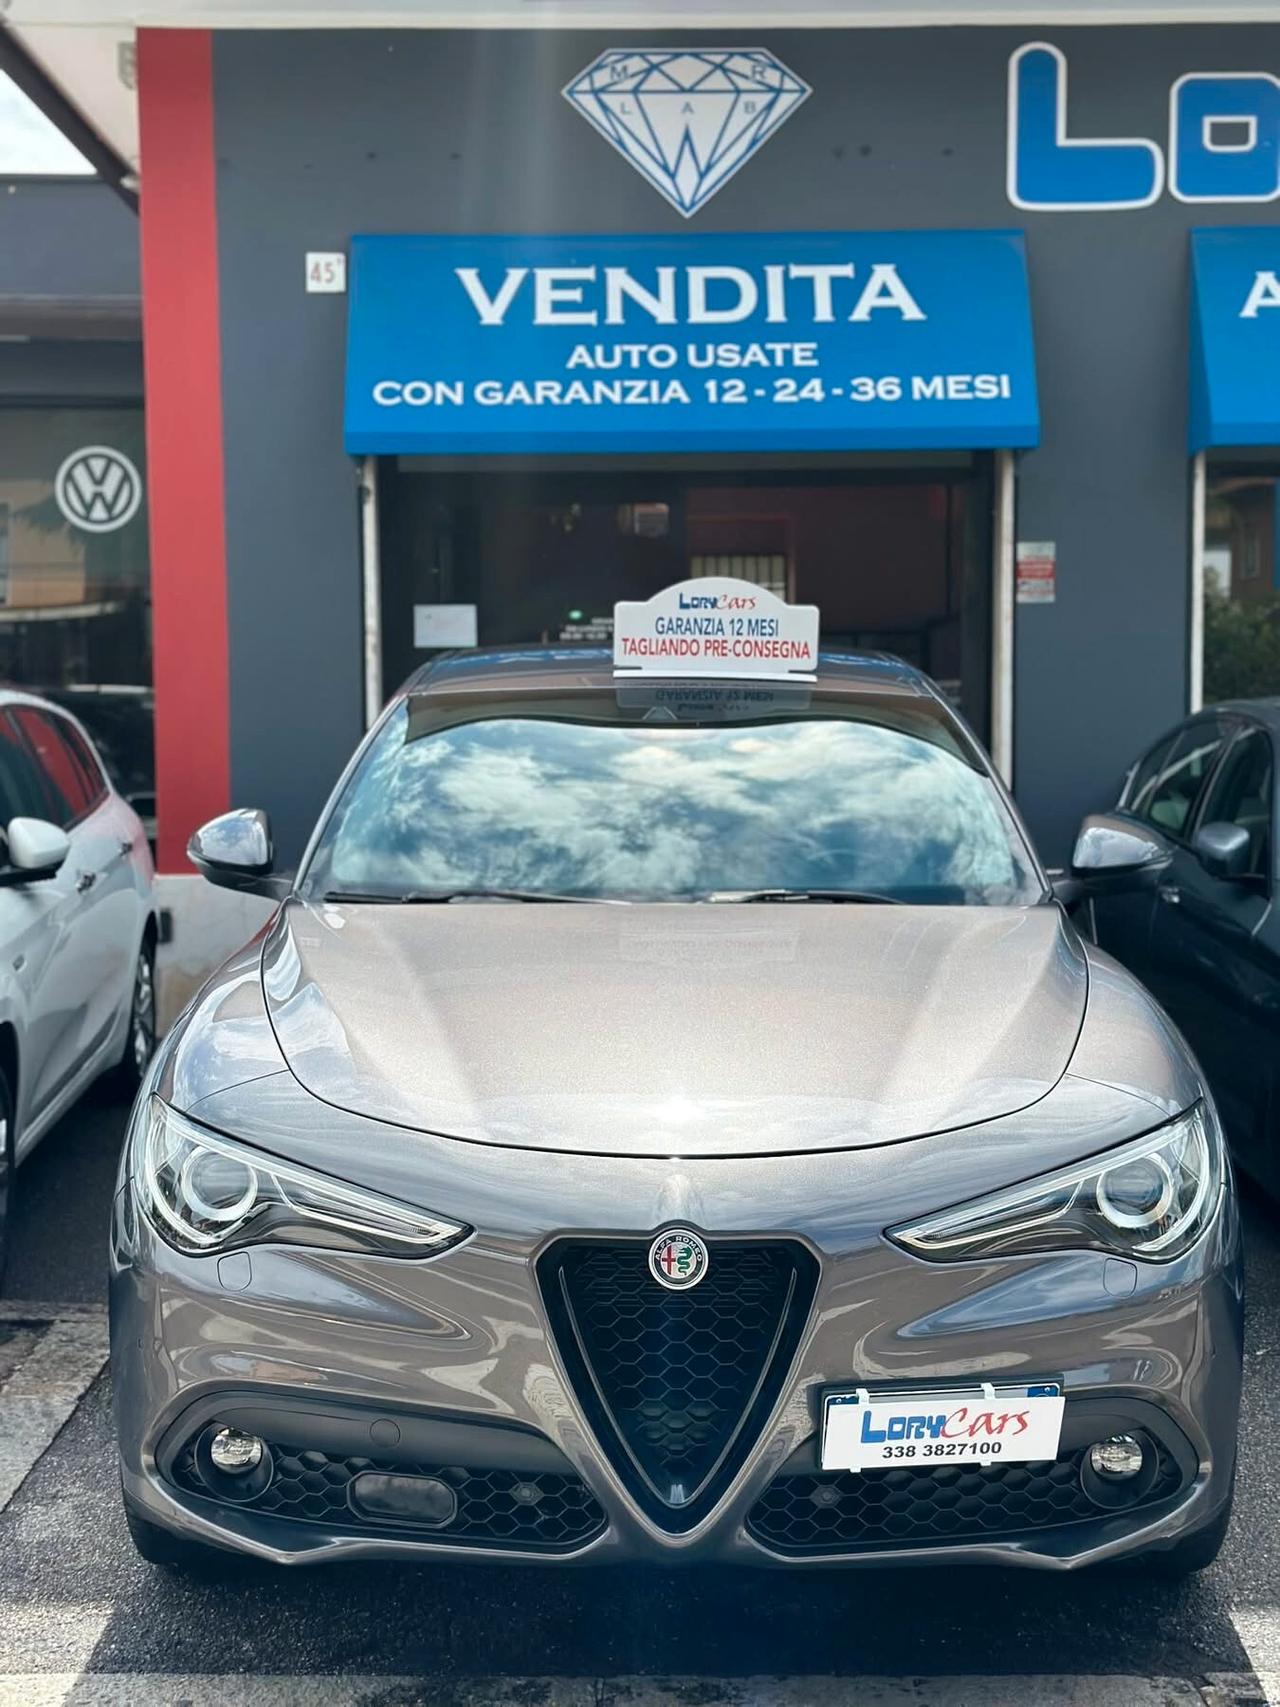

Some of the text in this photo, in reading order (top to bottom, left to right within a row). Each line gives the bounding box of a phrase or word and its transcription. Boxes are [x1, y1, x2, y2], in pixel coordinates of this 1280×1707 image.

[454, 263, 928, 326] VENDITA
[566, 342, 819, 369] AUTO USATE
[372, 380, 464, 406] CON
[473, 379, 691, 406] GARANZIA
[704, 378, 748, 404] 12
[772, 377, 825, 403] 24
[850, 375, 902, 401] 36
[911, 373, 1012, 401] MESI
[655, 616, 779, 637] GARANZIA 12 MESI
[622, 637, 811, 660] TAGLIANDO PRE-CONSEGNA
[655, 1235, 703, 1262] ALFA ROMEO
[882, 1441, 1002, 1459] 338 3827100
